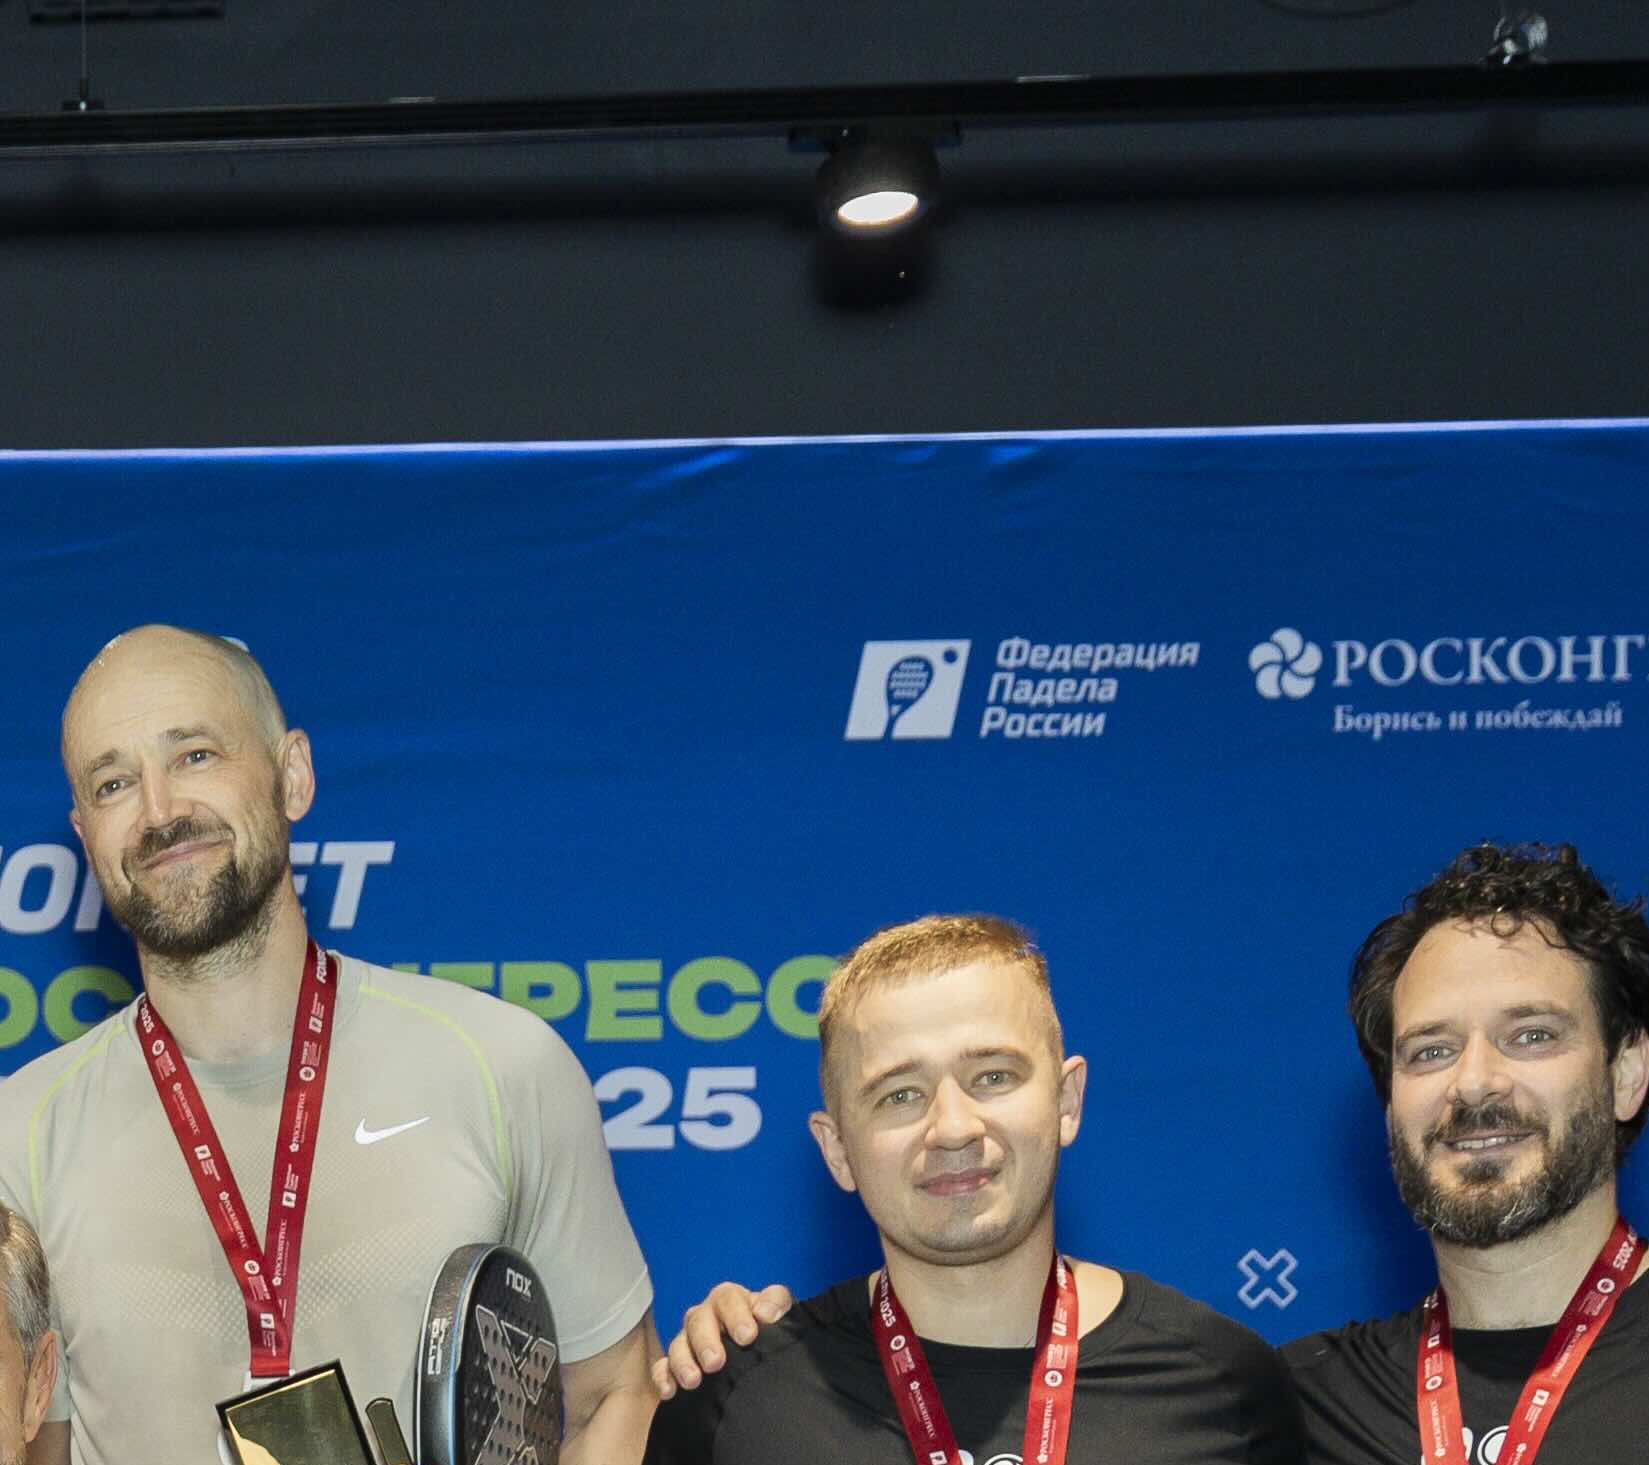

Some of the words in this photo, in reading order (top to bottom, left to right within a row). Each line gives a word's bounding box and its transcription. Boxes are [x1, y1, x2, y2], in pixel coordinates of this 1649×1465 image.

[996, 634, 1201, 675] Федерация
[987, 672, 1120, 708] Падела
[980, 704, 1108, 740] России
[1333, 703, 1442, 741] Борись
[1450, 712, 1468, 731] и
[1475, 698, 1624, 733] побеждай
